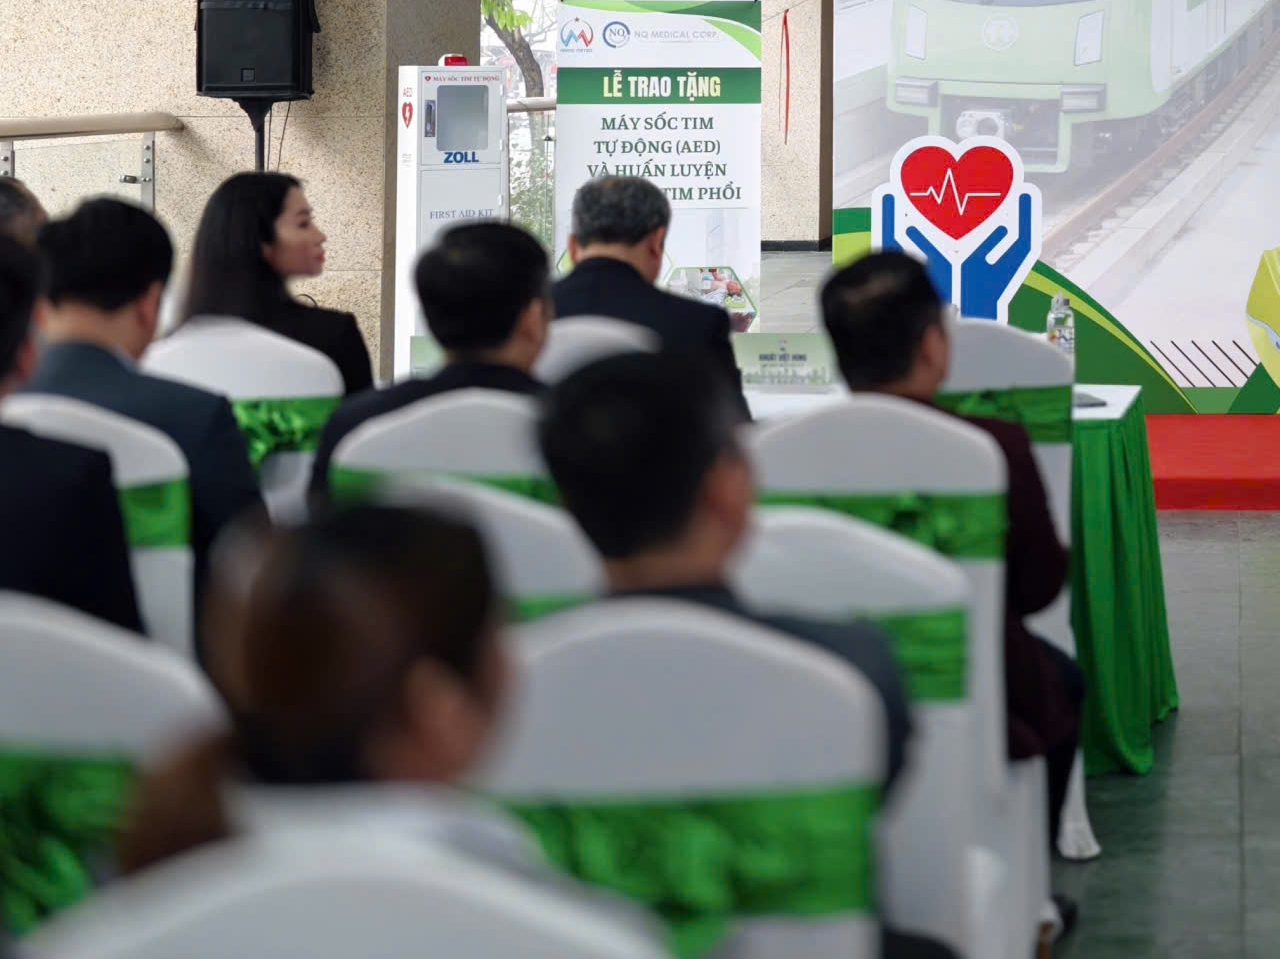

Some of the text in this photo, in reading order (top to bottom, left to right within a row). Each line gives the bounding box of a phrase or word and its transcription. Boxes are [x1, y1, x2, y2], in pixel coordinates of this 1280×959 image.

[609, 28, 626, 39] NQ
[634, 30, 720, 40] NQ MEDICAL CORP.
[603, 69, 721, 101] LỄ TRAO TẶNG
[601, 111, 714, 130] MÁY SỐC TIM
[593, 138, 721, 157] TỰ ĐỘNG (AED)
[443, 151, 480, 164] ZOLL
[587, 158, 727, 179] VÀ HUẤN LUYỆN
[698, 181, 742, 200] PHỔI
[430, 208, 494, 219] FIRST AID KIT
